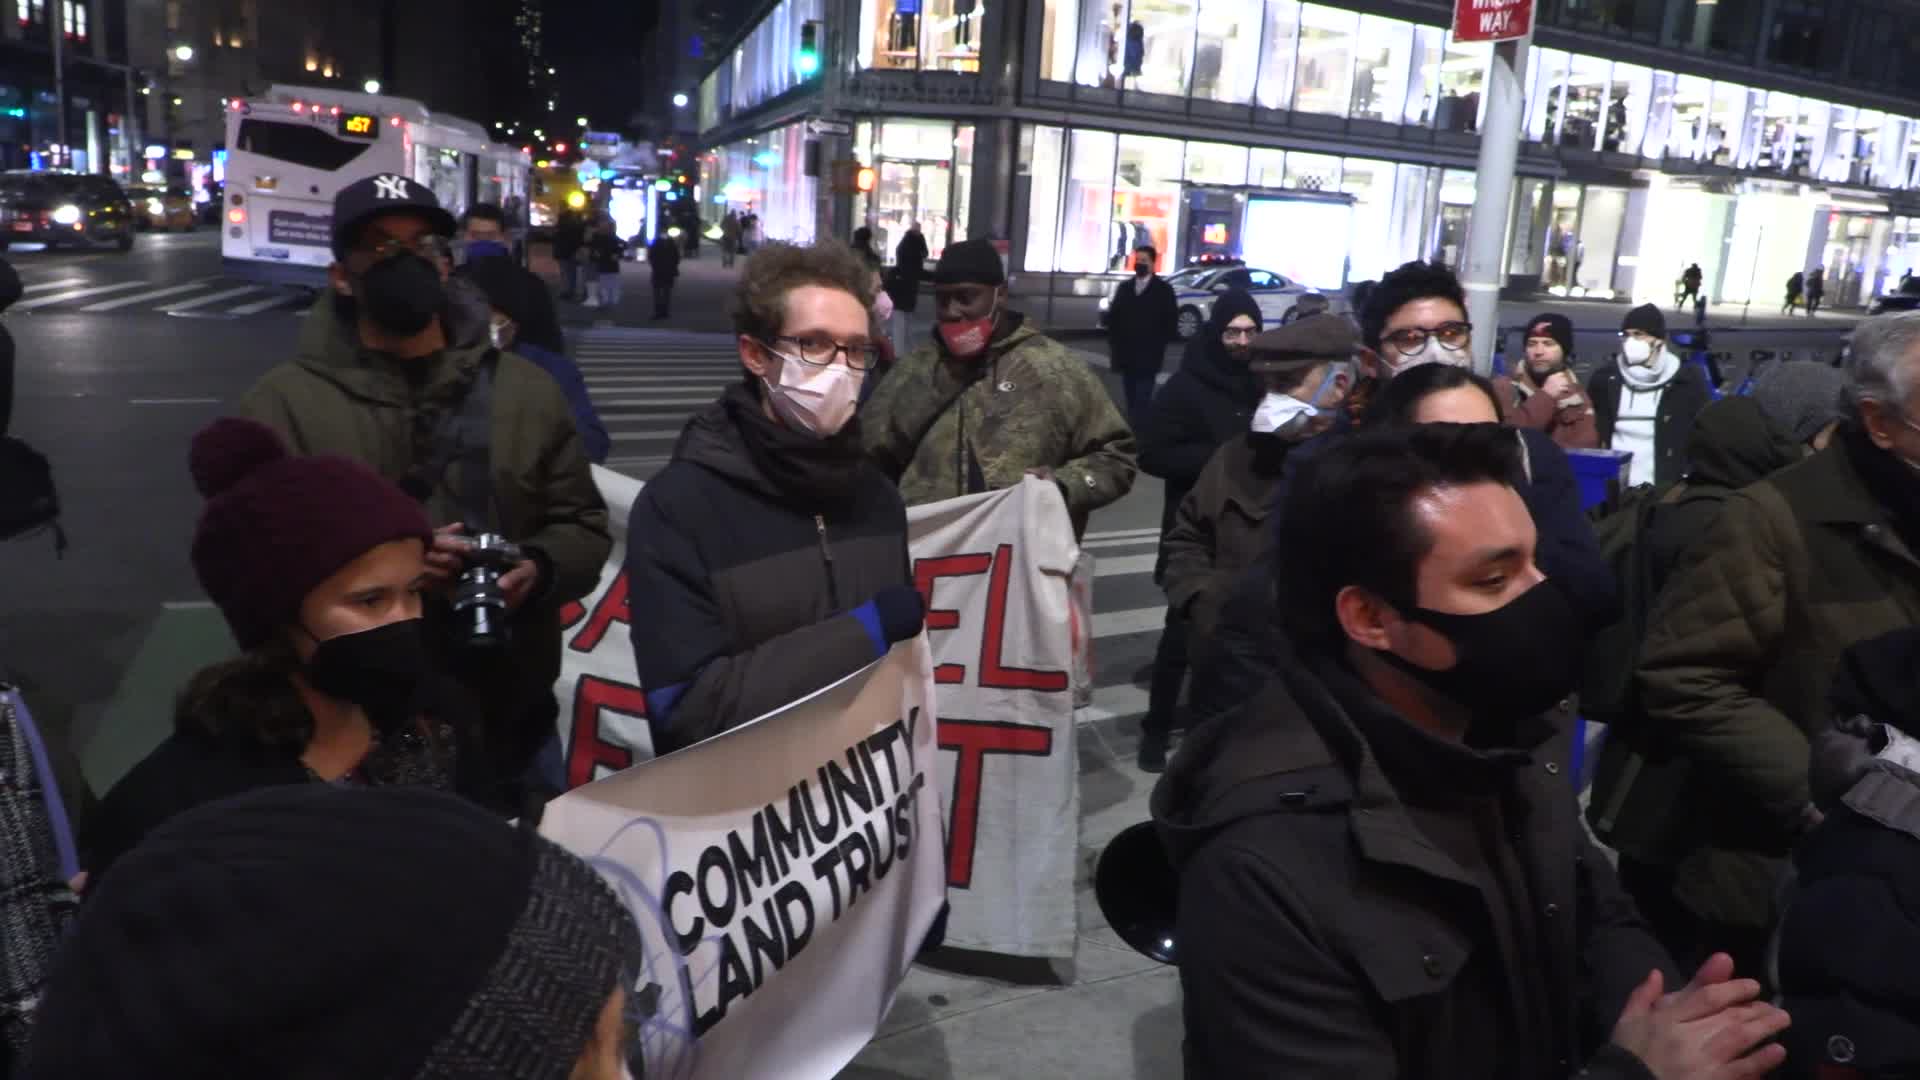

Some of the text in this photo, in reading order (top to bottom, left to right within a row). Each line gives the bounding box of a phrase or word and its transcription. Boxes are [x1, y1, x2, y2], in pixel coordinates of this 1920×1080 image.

[1480, 10, 1512, 32] WAY
[373, 175, 409, 199] NY
[663, 706, 920, 956] COMMUNITY
[680, 771, 924, 1038] LAND TRUST
